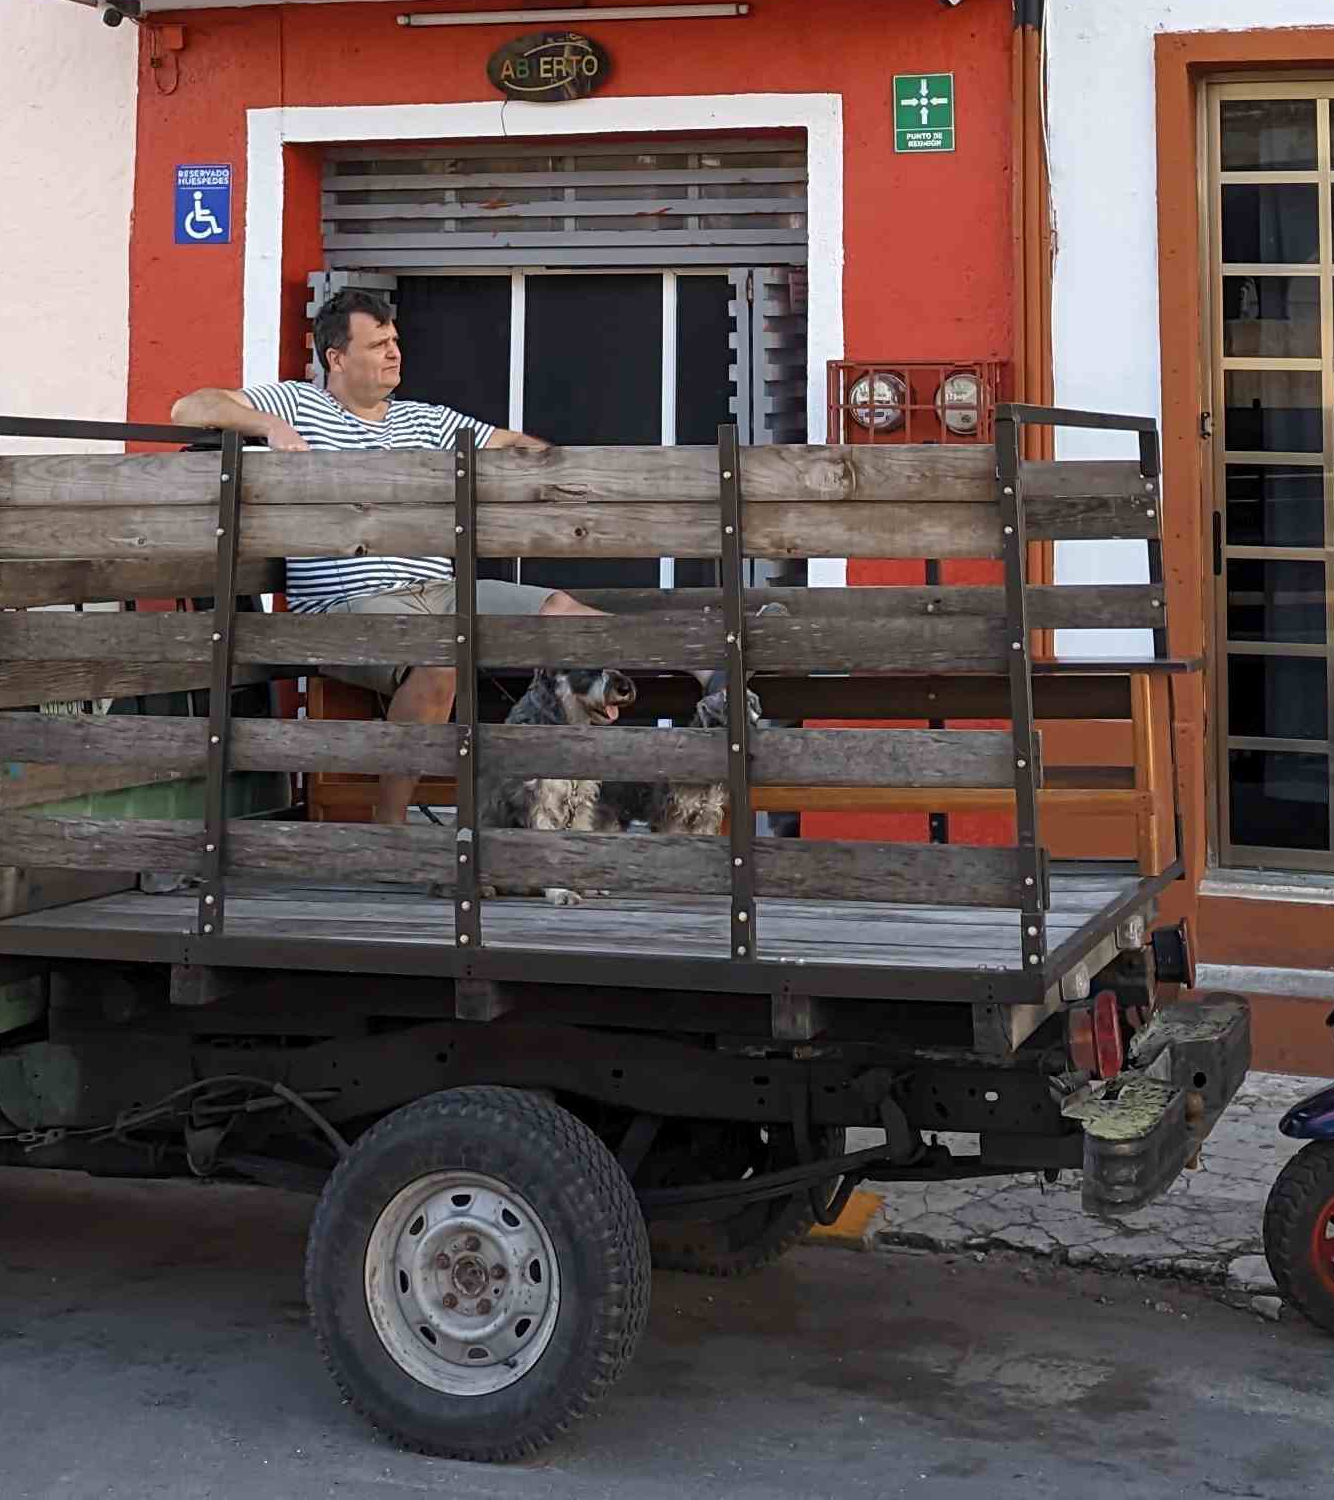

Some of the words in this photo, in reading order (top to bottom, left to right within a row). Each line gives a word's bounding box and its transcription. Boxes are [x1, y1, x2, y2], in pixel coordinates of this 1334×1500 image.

[500, 55, 599, 79] ABERTO
[906, 132, 932, 140] PUNTO
[178, 169, 229, 178] RESERVADO
